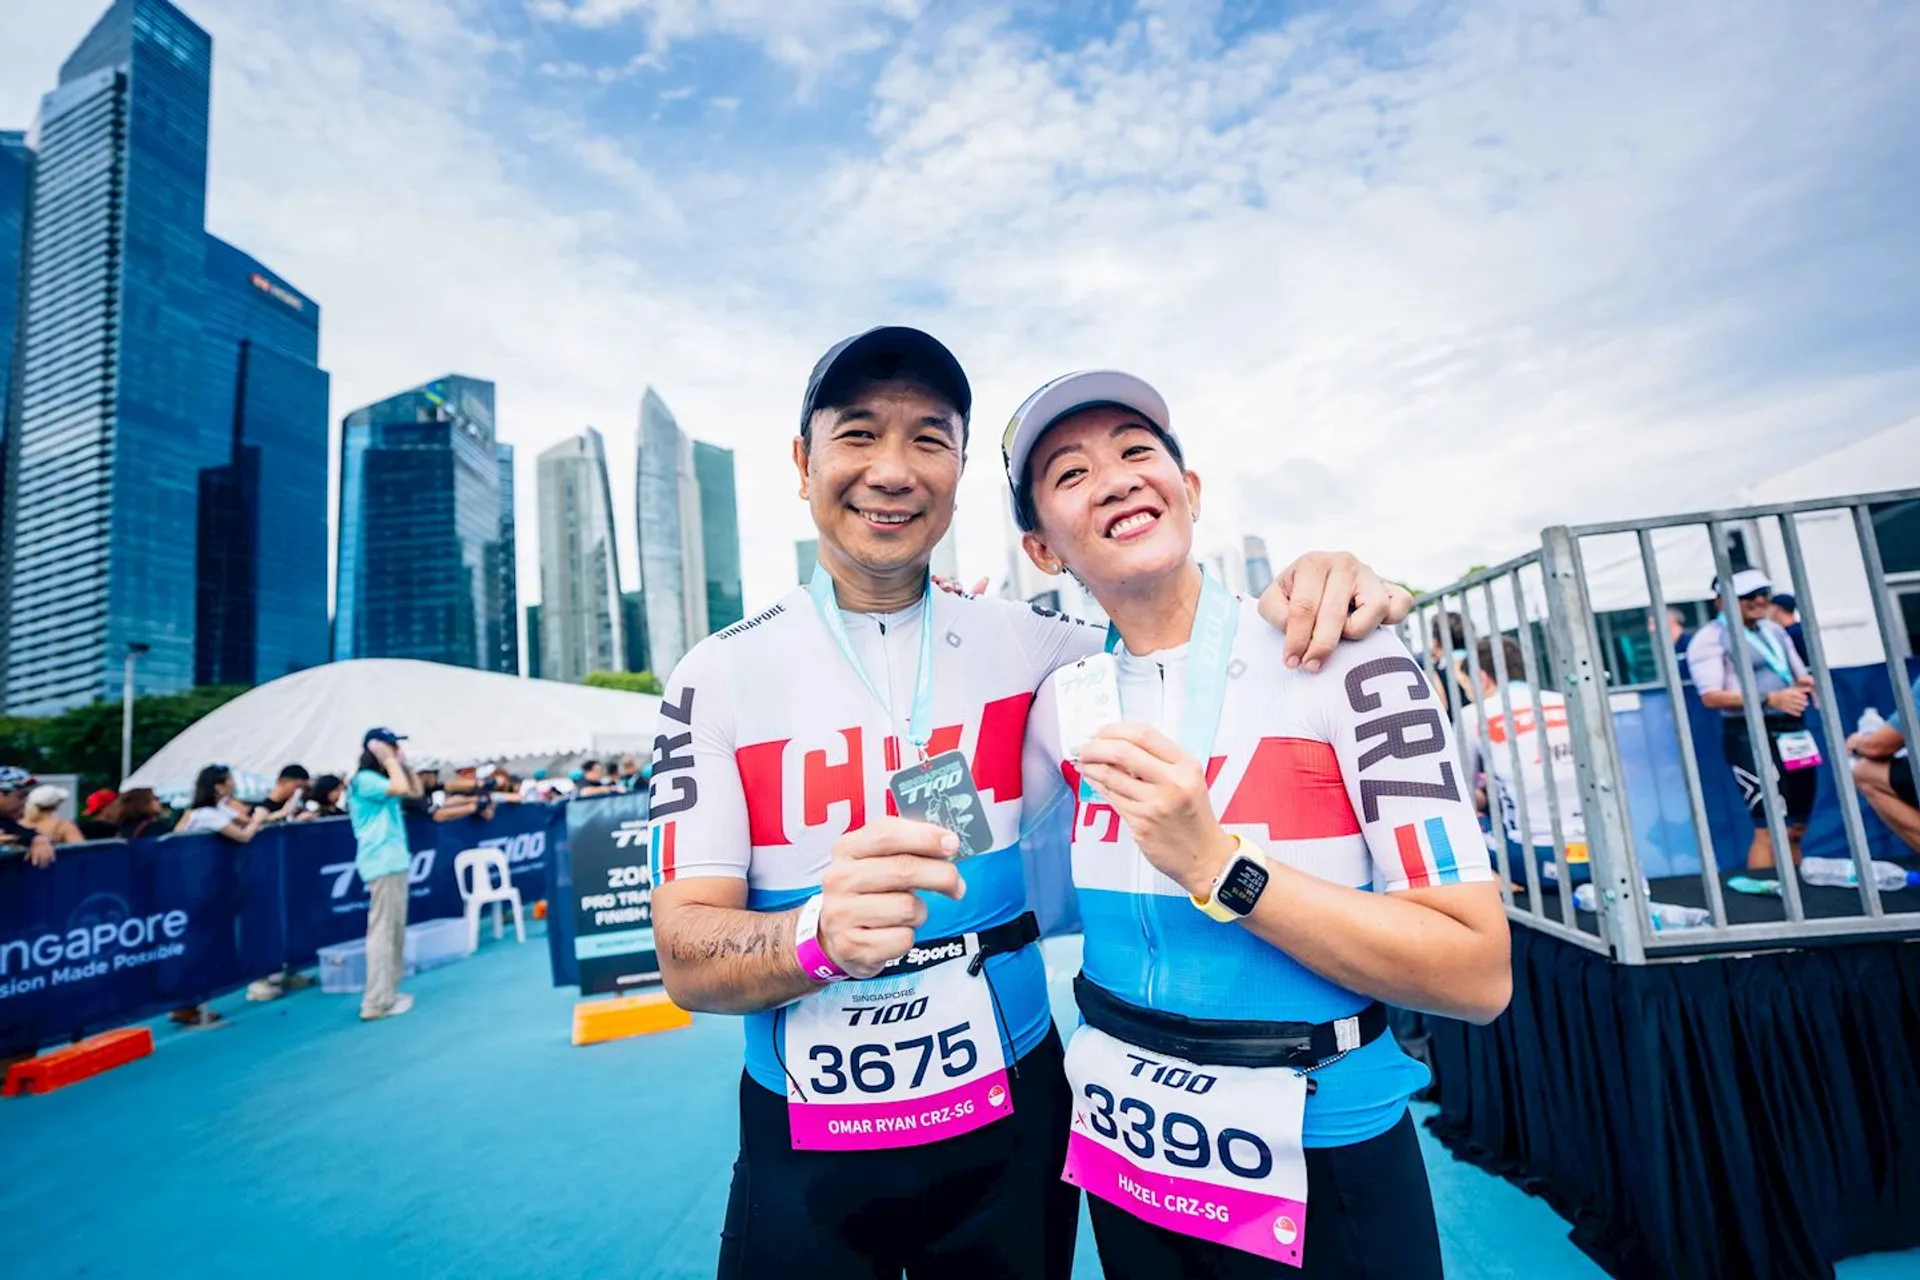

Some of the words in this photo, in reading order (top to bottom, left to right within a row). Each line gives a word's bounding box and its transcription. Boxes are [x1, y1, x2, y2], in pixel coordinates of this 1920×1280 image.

[716, 603, 786, 640] SINGAPORE
[649, 687, 698, 822] CRZ
[1345, 656, 1461, 824] CRZ
[900, 768, 963, 805] T100
[581, 894, 616, 911] PRO
[52, 959, 109, 985] Made
[906, 942, 964, 965] Sports
[841, 996, 929, 1026] T100
[852, 988, 916, 1003] SINGAPORE
[809, 1021, 978, 1094] 3675
[1126, 1053, 1217, 1095] T100
[828, 1119, 873, 1134] OMAR
[875, 1114, 917, 1132] RYAN
[920, 1099, 975, 1126] CRZ-SG
[1084, 1083, 1273, 1179] 3390
[1118, 1173, 1161, 1208] HAZEL
[1164, 1194, 1230, 1223] CRZ-SG
